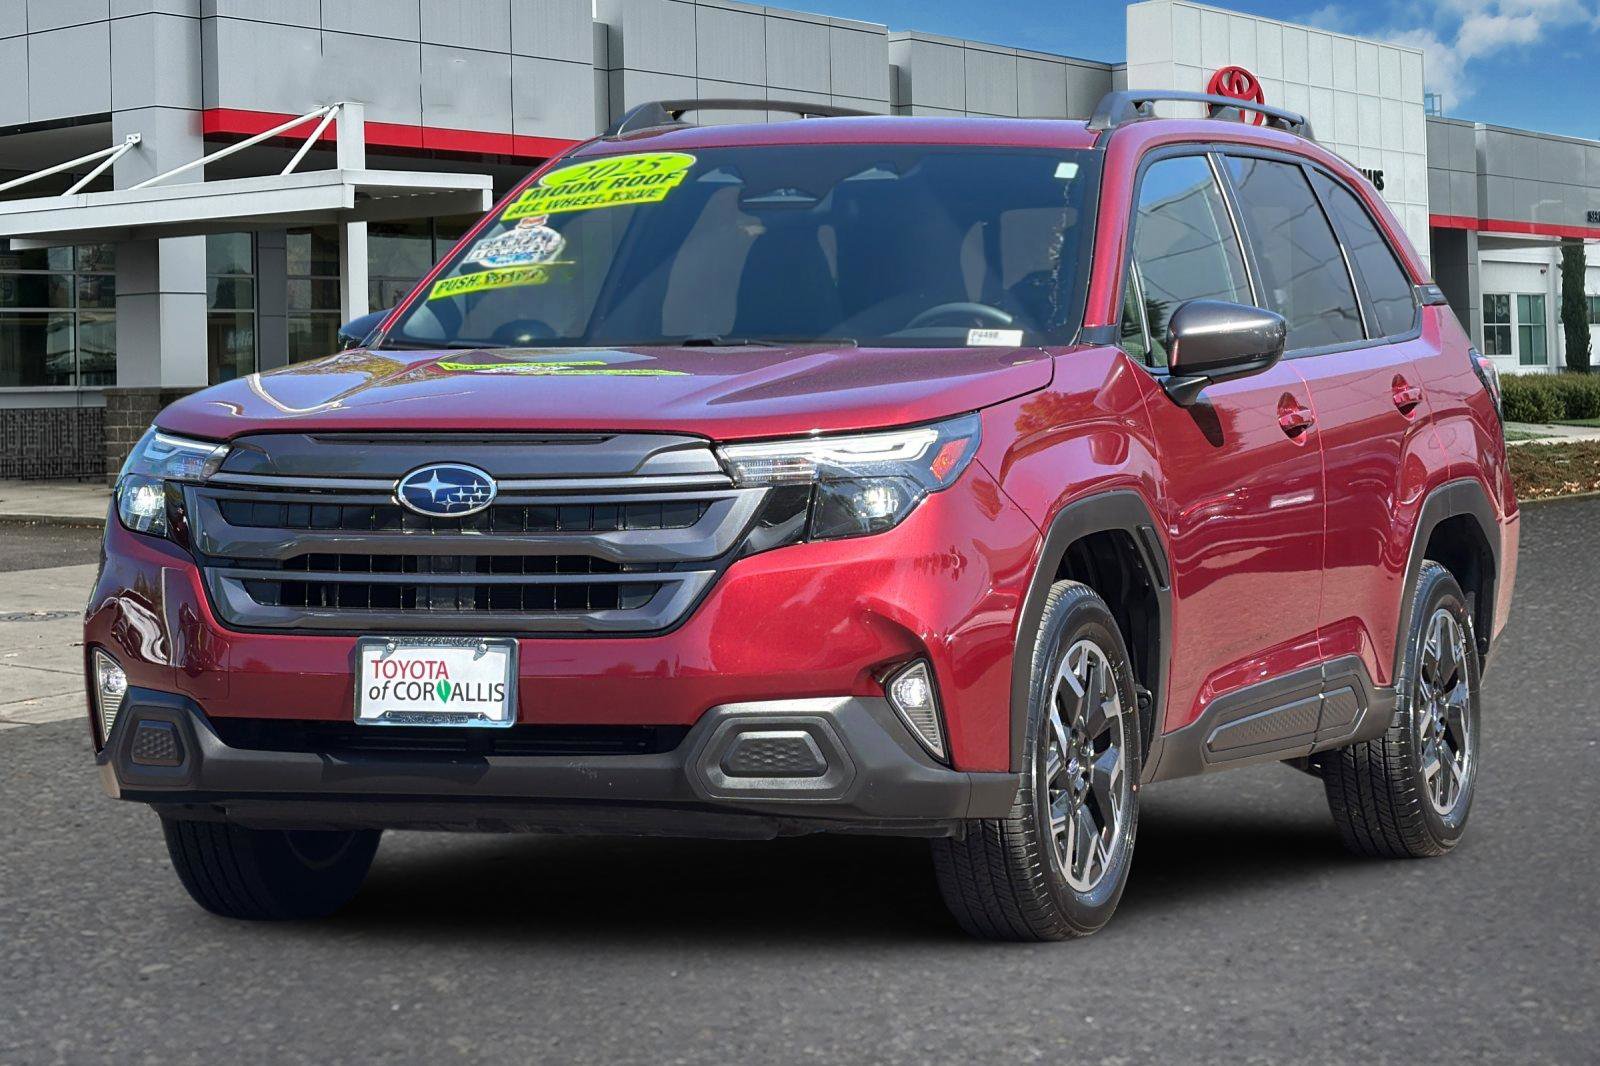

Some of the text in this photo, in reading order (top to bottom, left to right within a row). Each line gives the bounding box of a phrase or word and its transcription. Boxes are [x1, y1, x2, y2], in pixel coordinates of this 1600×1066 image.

[563, 157, 673, 183] 2025
[527, 171, 680, 201] MOON ROOF
[371, 660, 450, 680] TOYOTA
[369, 679, 505, 704] of CORVALLIS
